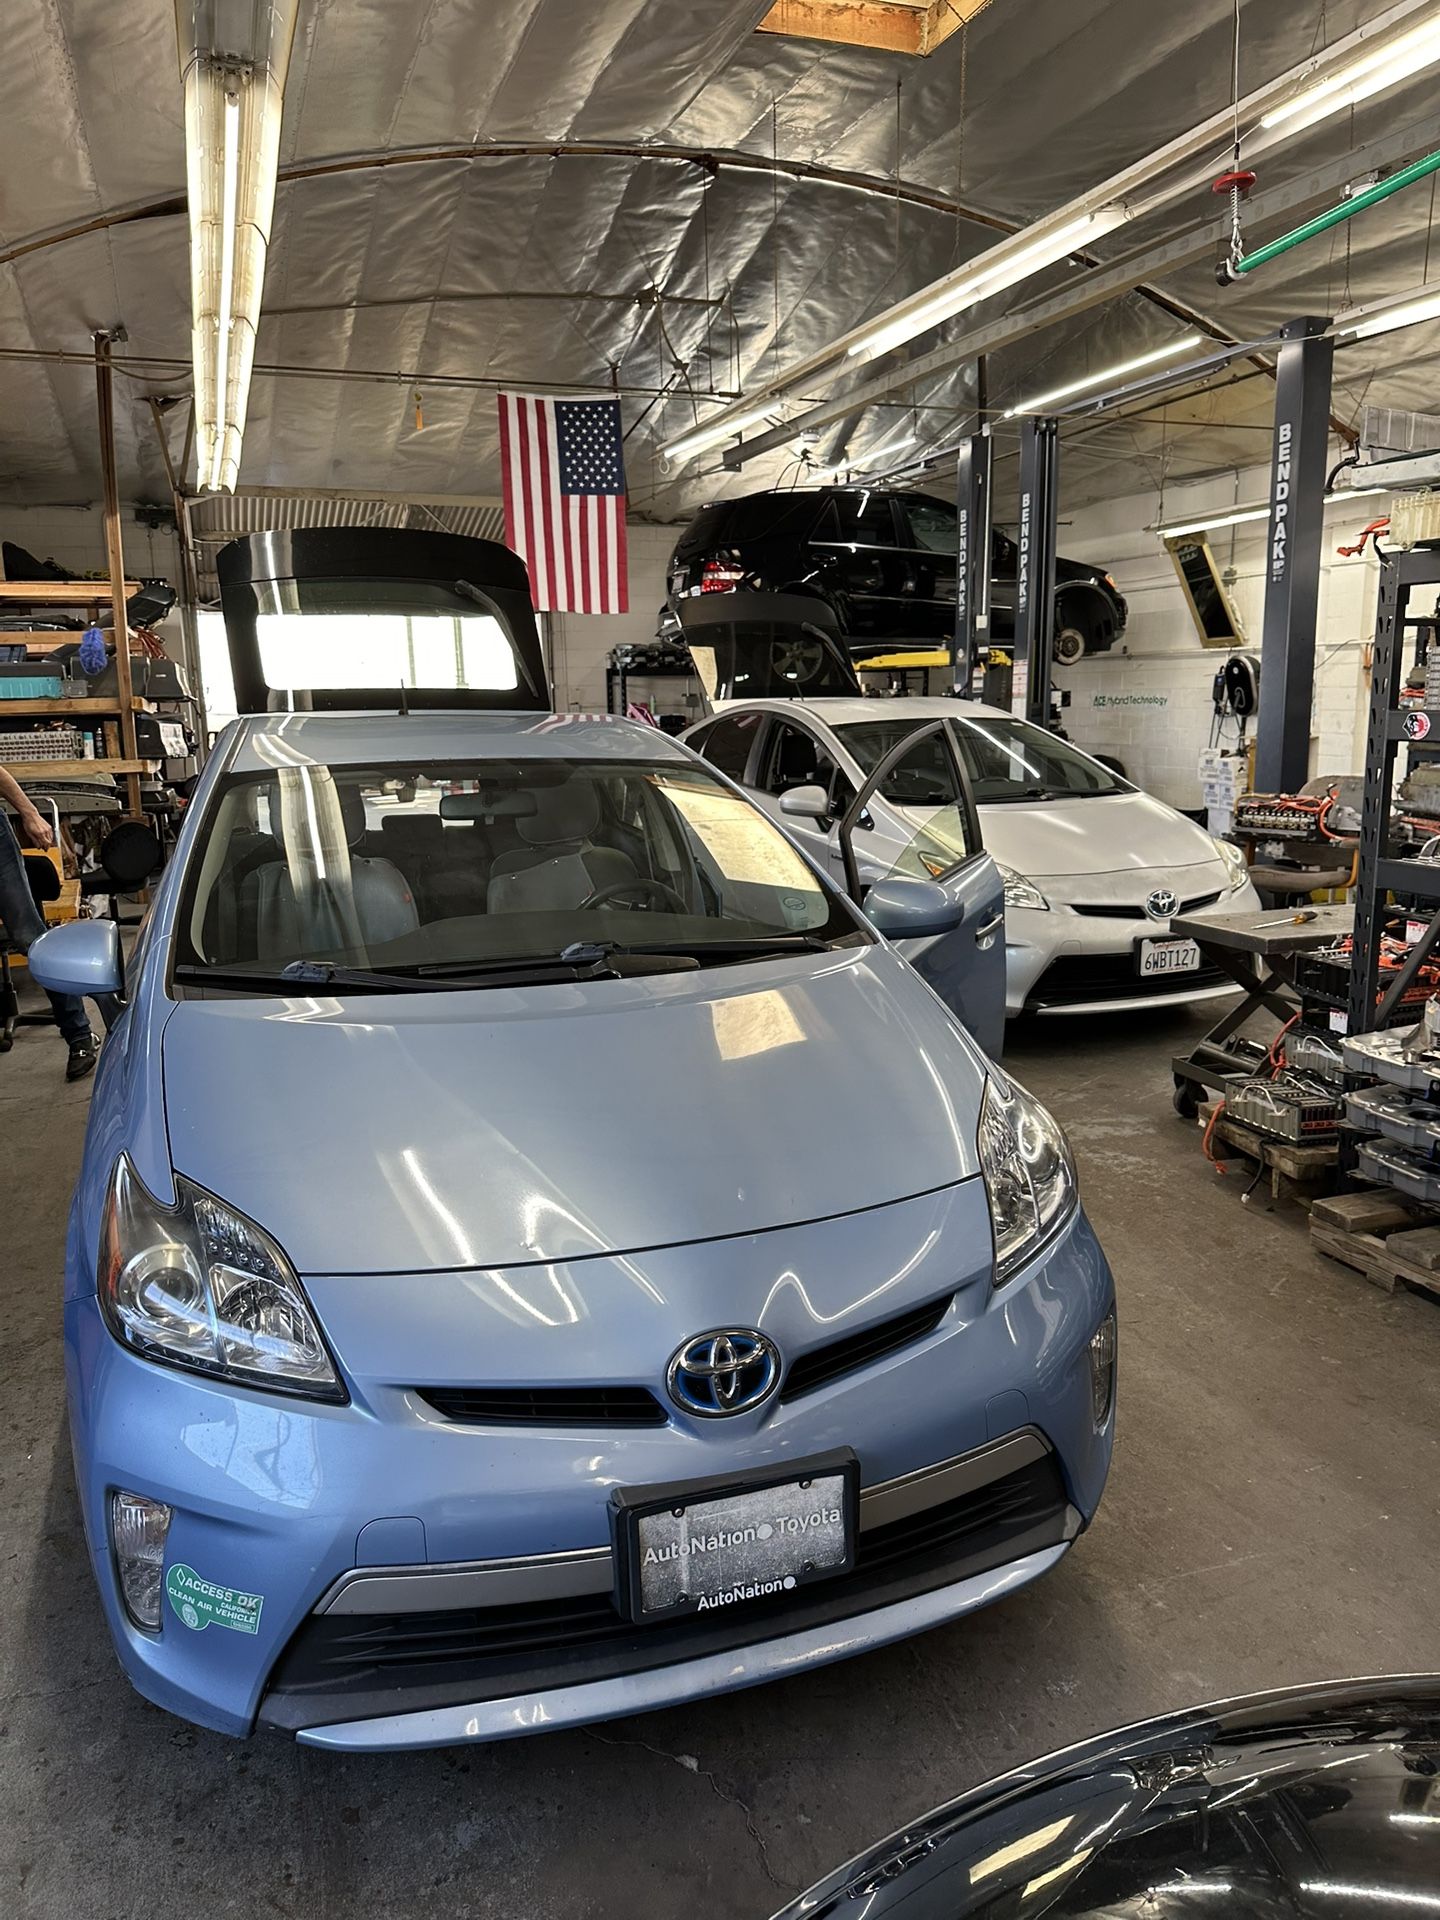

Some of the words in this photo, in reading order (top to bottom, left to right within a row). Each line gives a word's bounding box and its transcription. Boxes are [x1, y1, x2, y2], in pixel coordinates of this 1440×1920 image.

[1272, 423, 1291, 560] BENDPAK
[958, 509, 967, 605] BENDPAK
[1019, 493, 1030, 596] BENDPAK
[1145, 948, 1196, 970] 6HBT127
[643, 1528, 755, 1566] AutoNation
[776, 1508, 841, 1536] Toyota
[168, 1587, 195, 1604] CLEAN
[197, 1600, 213, 1612] AIR
[215, 1607, 257, 1624] VEHICLE
[185, 1577, 233, 1602] ACCESS
[697, 1580, 783, 1611] AutoNation
